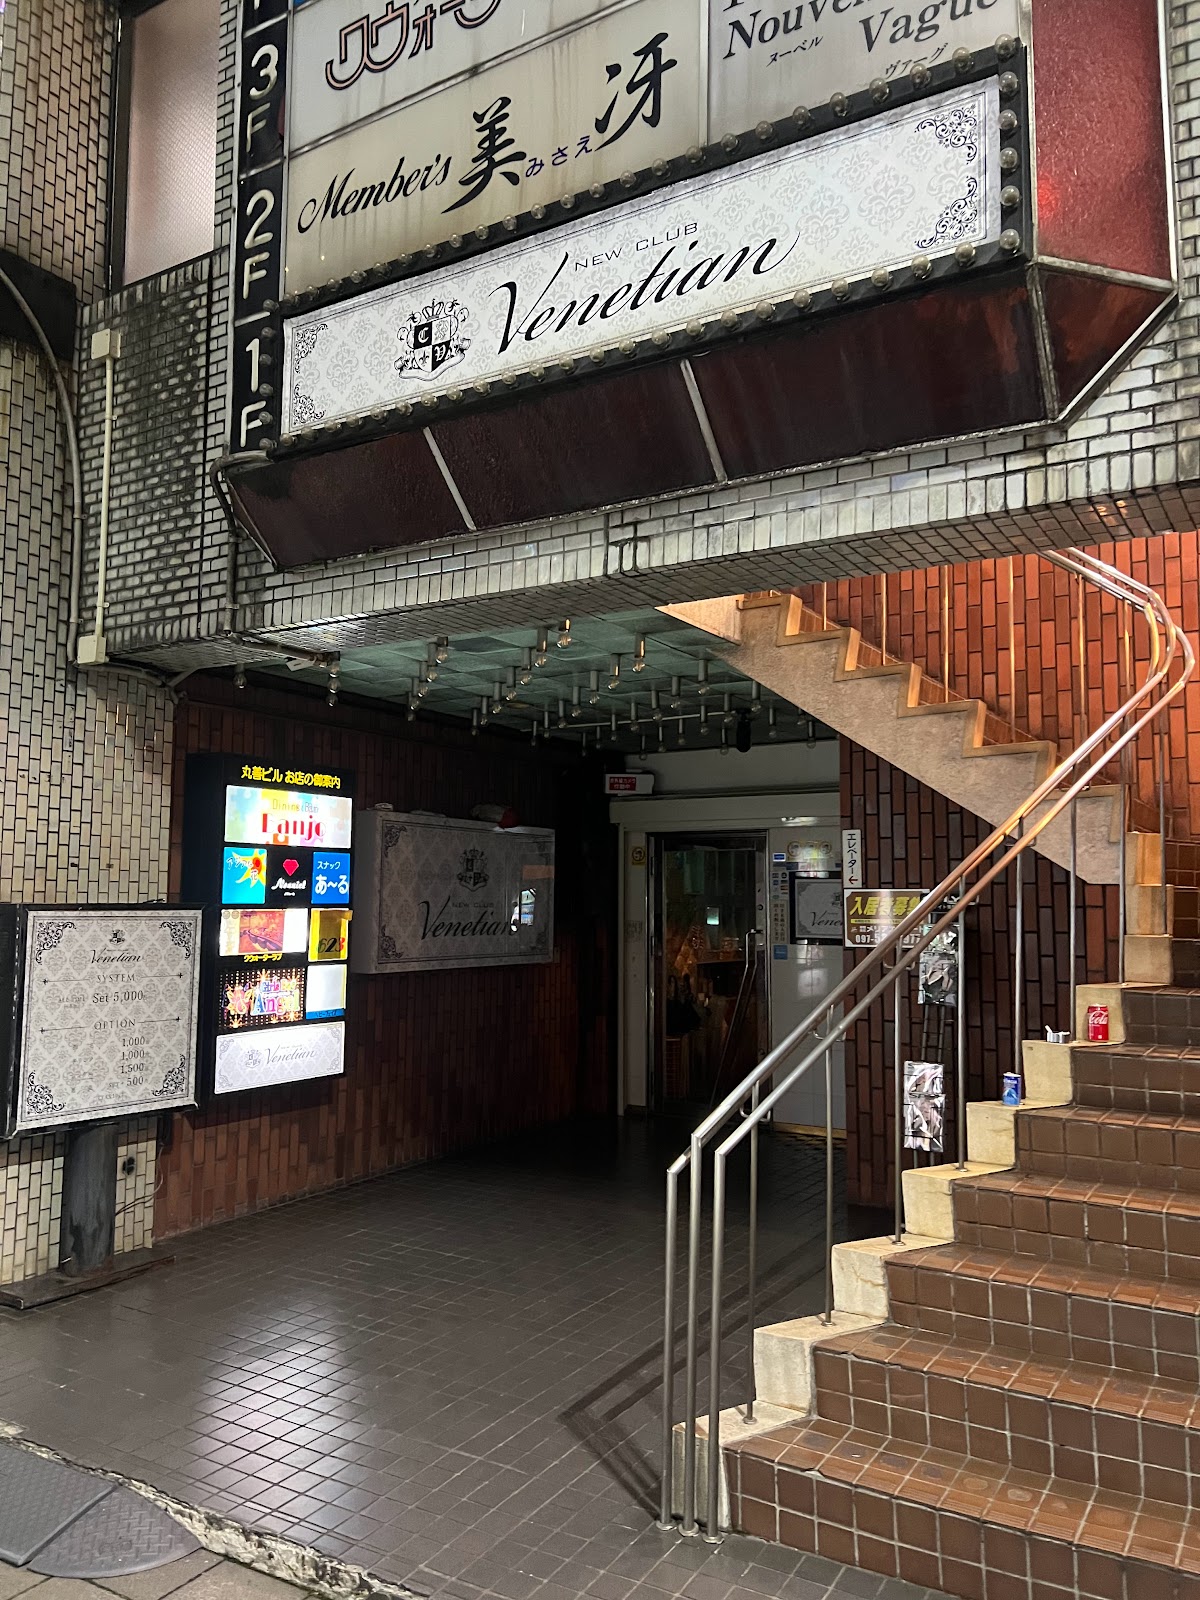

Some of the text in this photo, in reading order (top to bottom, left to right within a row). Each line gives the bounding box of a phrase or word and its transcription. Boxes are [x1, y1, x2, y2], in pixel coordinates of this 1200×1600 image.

[766, 36, 823, 67] ヌーベル
[885, 42, 949, 78] ヴァーグ
[525, 135, 593, 178] みさえ
[297, 151, 451, 234] Member's
[575, 222, 699, 272] NEW CLUB
[488, 231, 800, 355] Venetian
[317, 861, 341, 870] スナック
[847, 833, 858, 875] エレベーター
[90, 947, 142, 964] Venetian
[95, 973, 136, 983] SYSTEM
[92, 992, 110, 1004] Set
[94, 1019, 136, 1031] OPTION
[264, 1044, 317, 1065] Venetian
